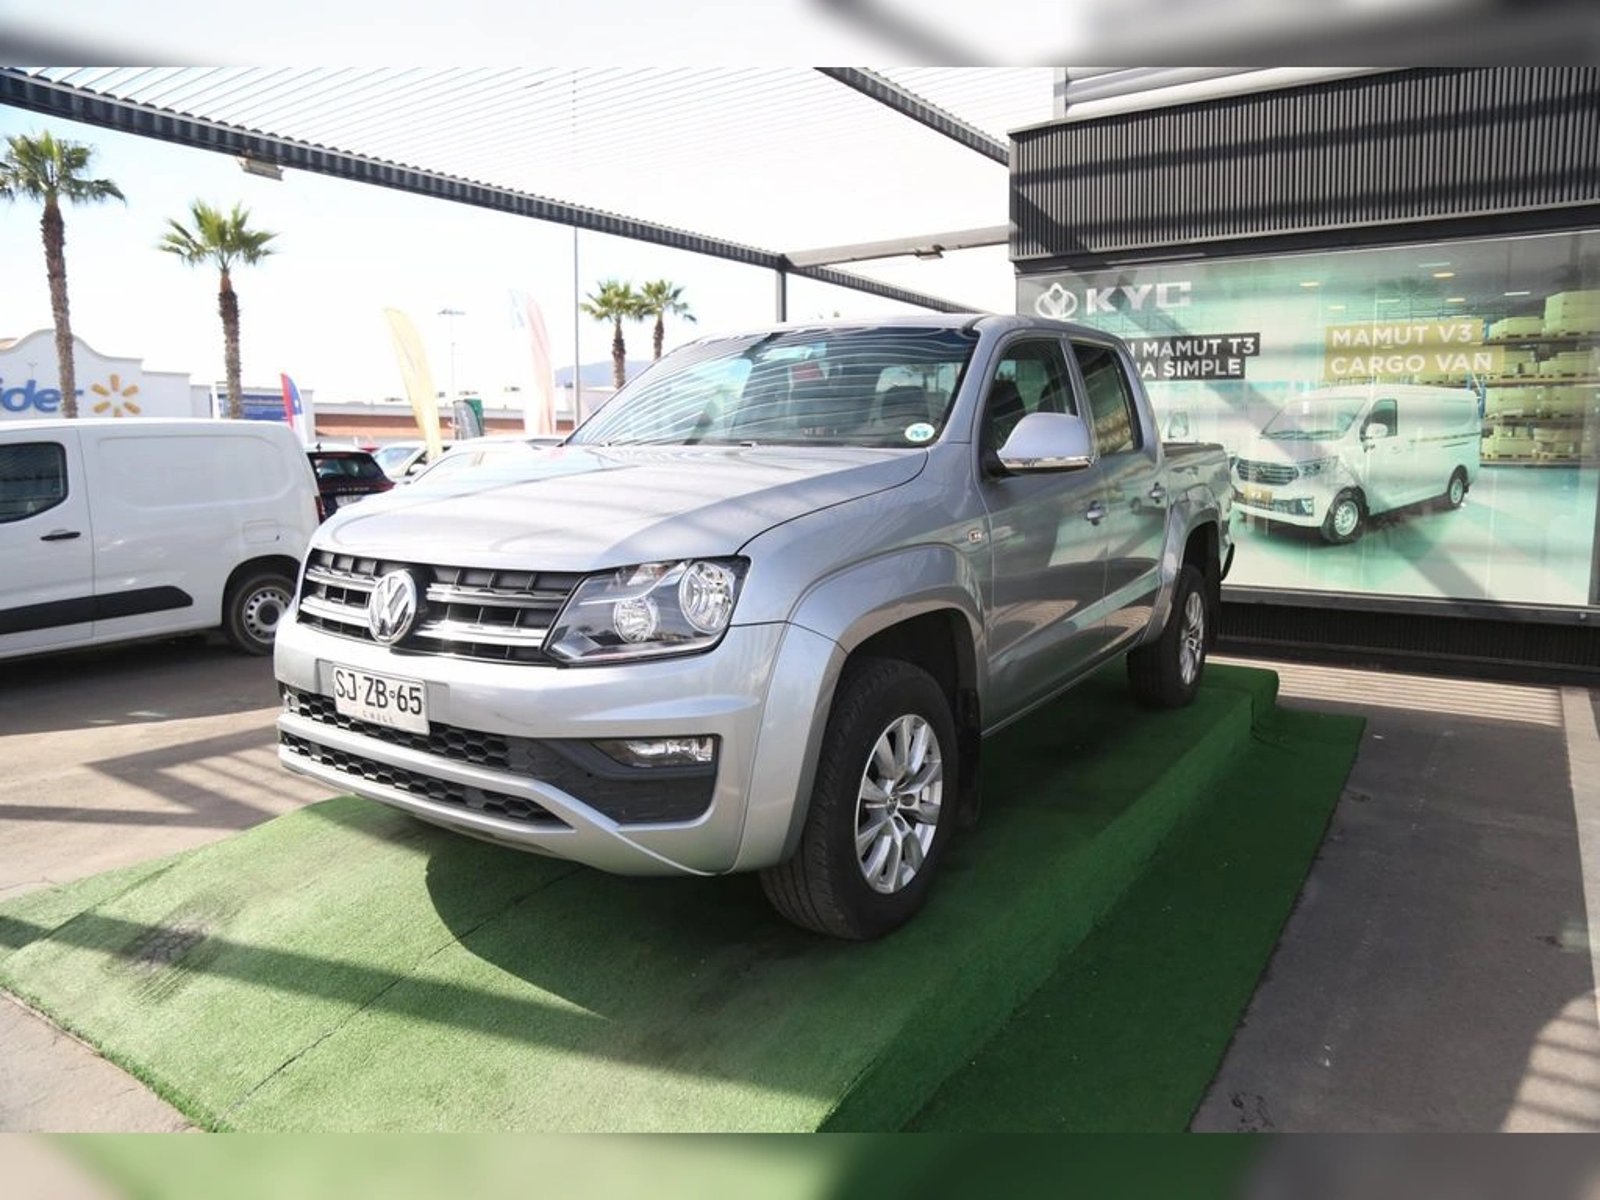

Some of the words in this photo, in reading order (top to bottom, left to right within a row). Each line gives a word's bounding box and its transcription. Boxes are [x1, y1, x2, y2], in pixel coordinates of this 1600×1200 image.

[1086, 281, 1191, 315] KYC
[1332, 325, 1428, 347] MAMUT
[1438, 323, 1473, 343] V3
[1143, 338, 1222, 358] MAMUT
[1228, 337, 1256, 355] T3
[1163, 358, 1241, 377] SIMPLE
[1331, 354, 1425, 375] CARGO
[1435, 352, 1492, 372] VAN
